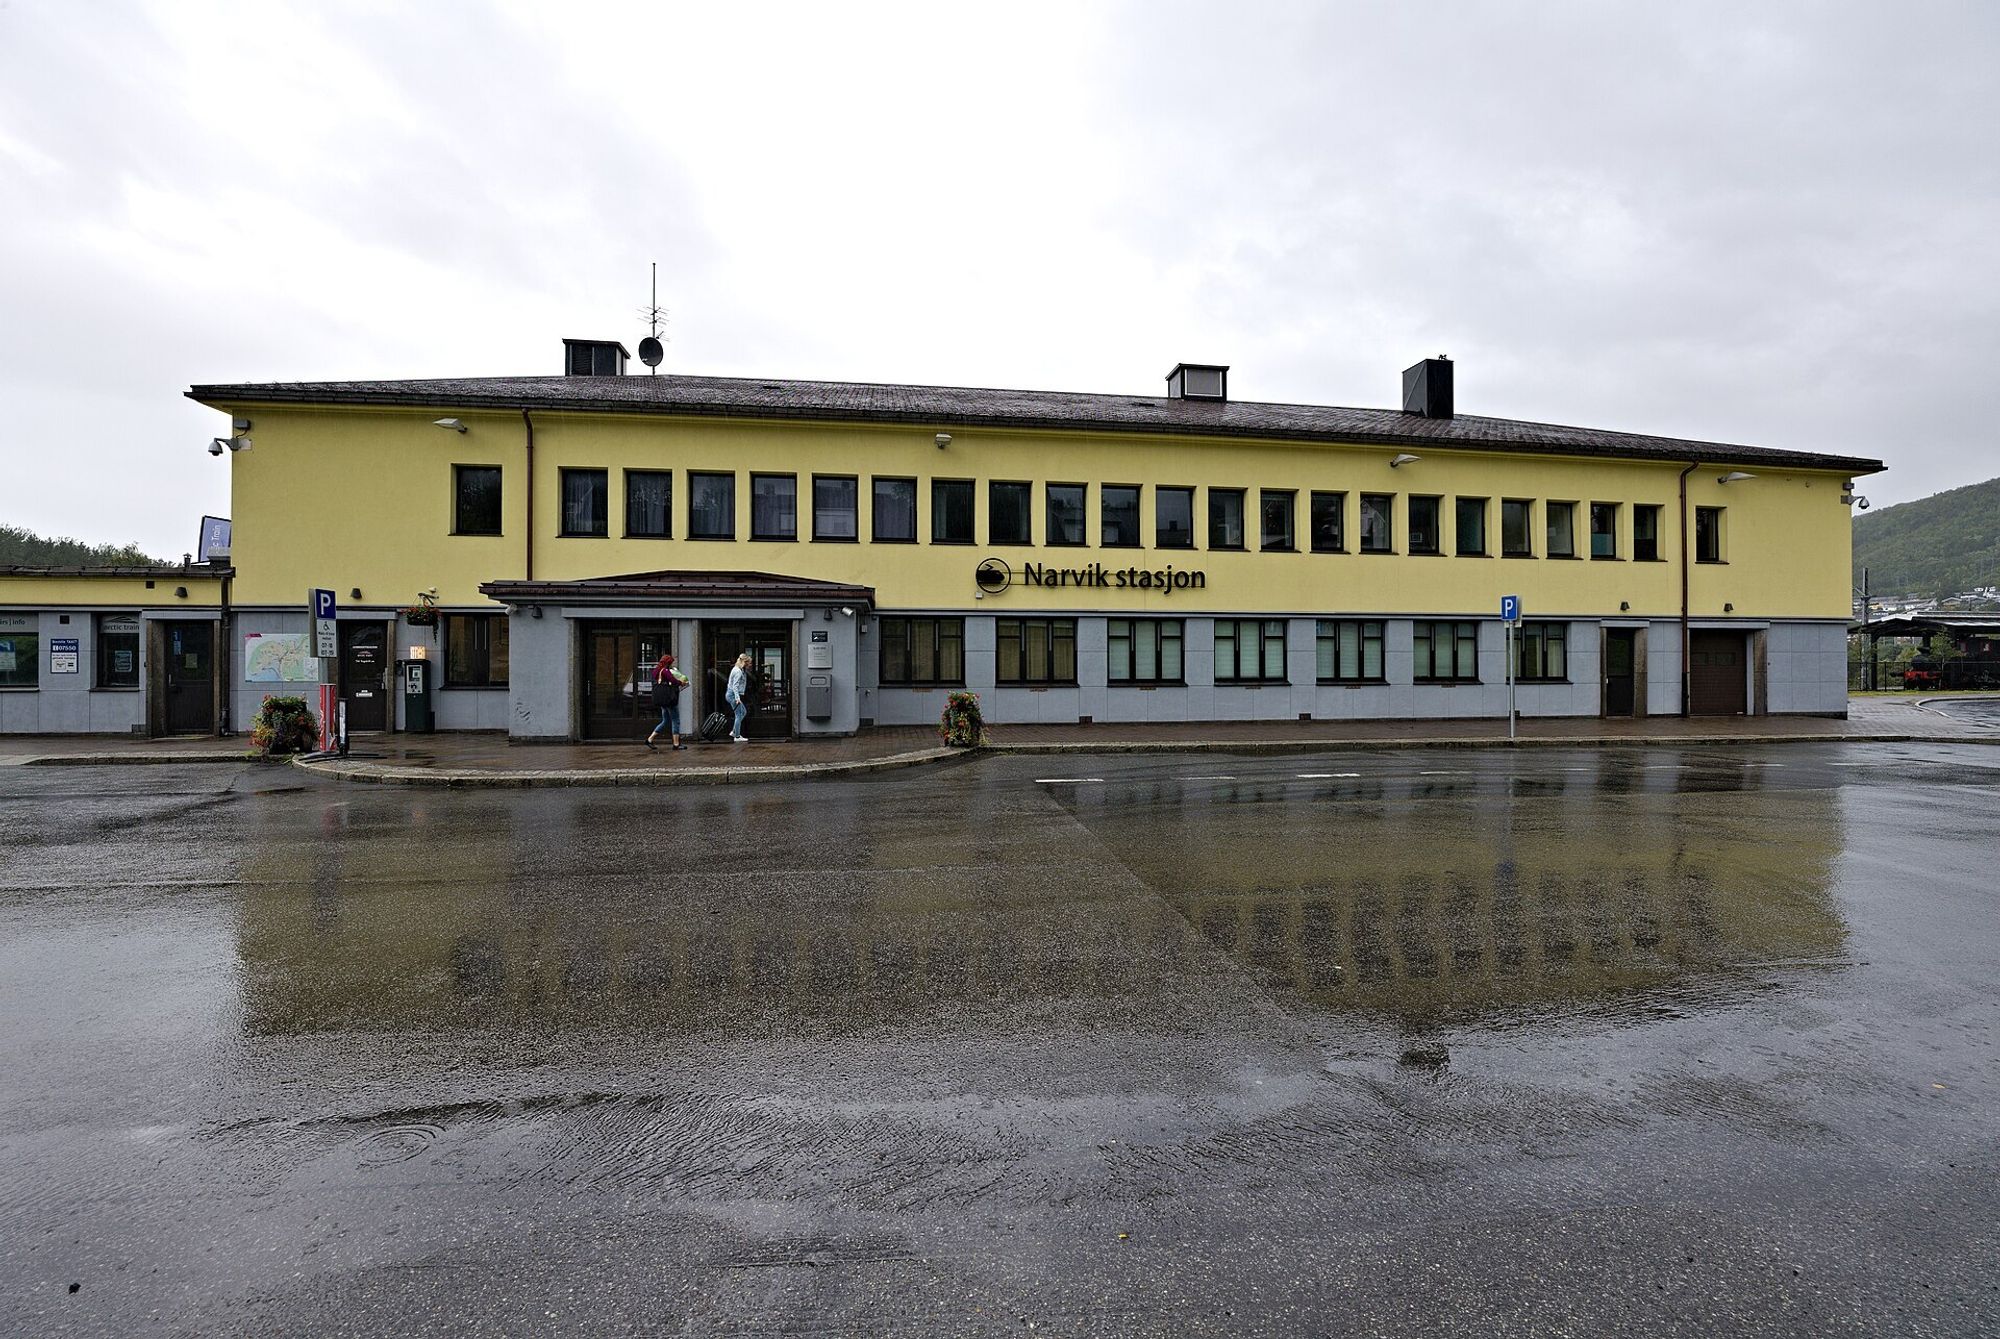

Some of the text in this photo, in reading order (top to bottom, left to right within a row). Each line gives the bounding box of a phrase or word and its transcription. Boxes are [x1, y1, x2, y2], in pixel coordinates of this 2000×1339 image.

[1024, 562, 1206, 595] Narvik stasjon
[320, 593, 331, 615] P
[1505, 599, 1513, 617] P
